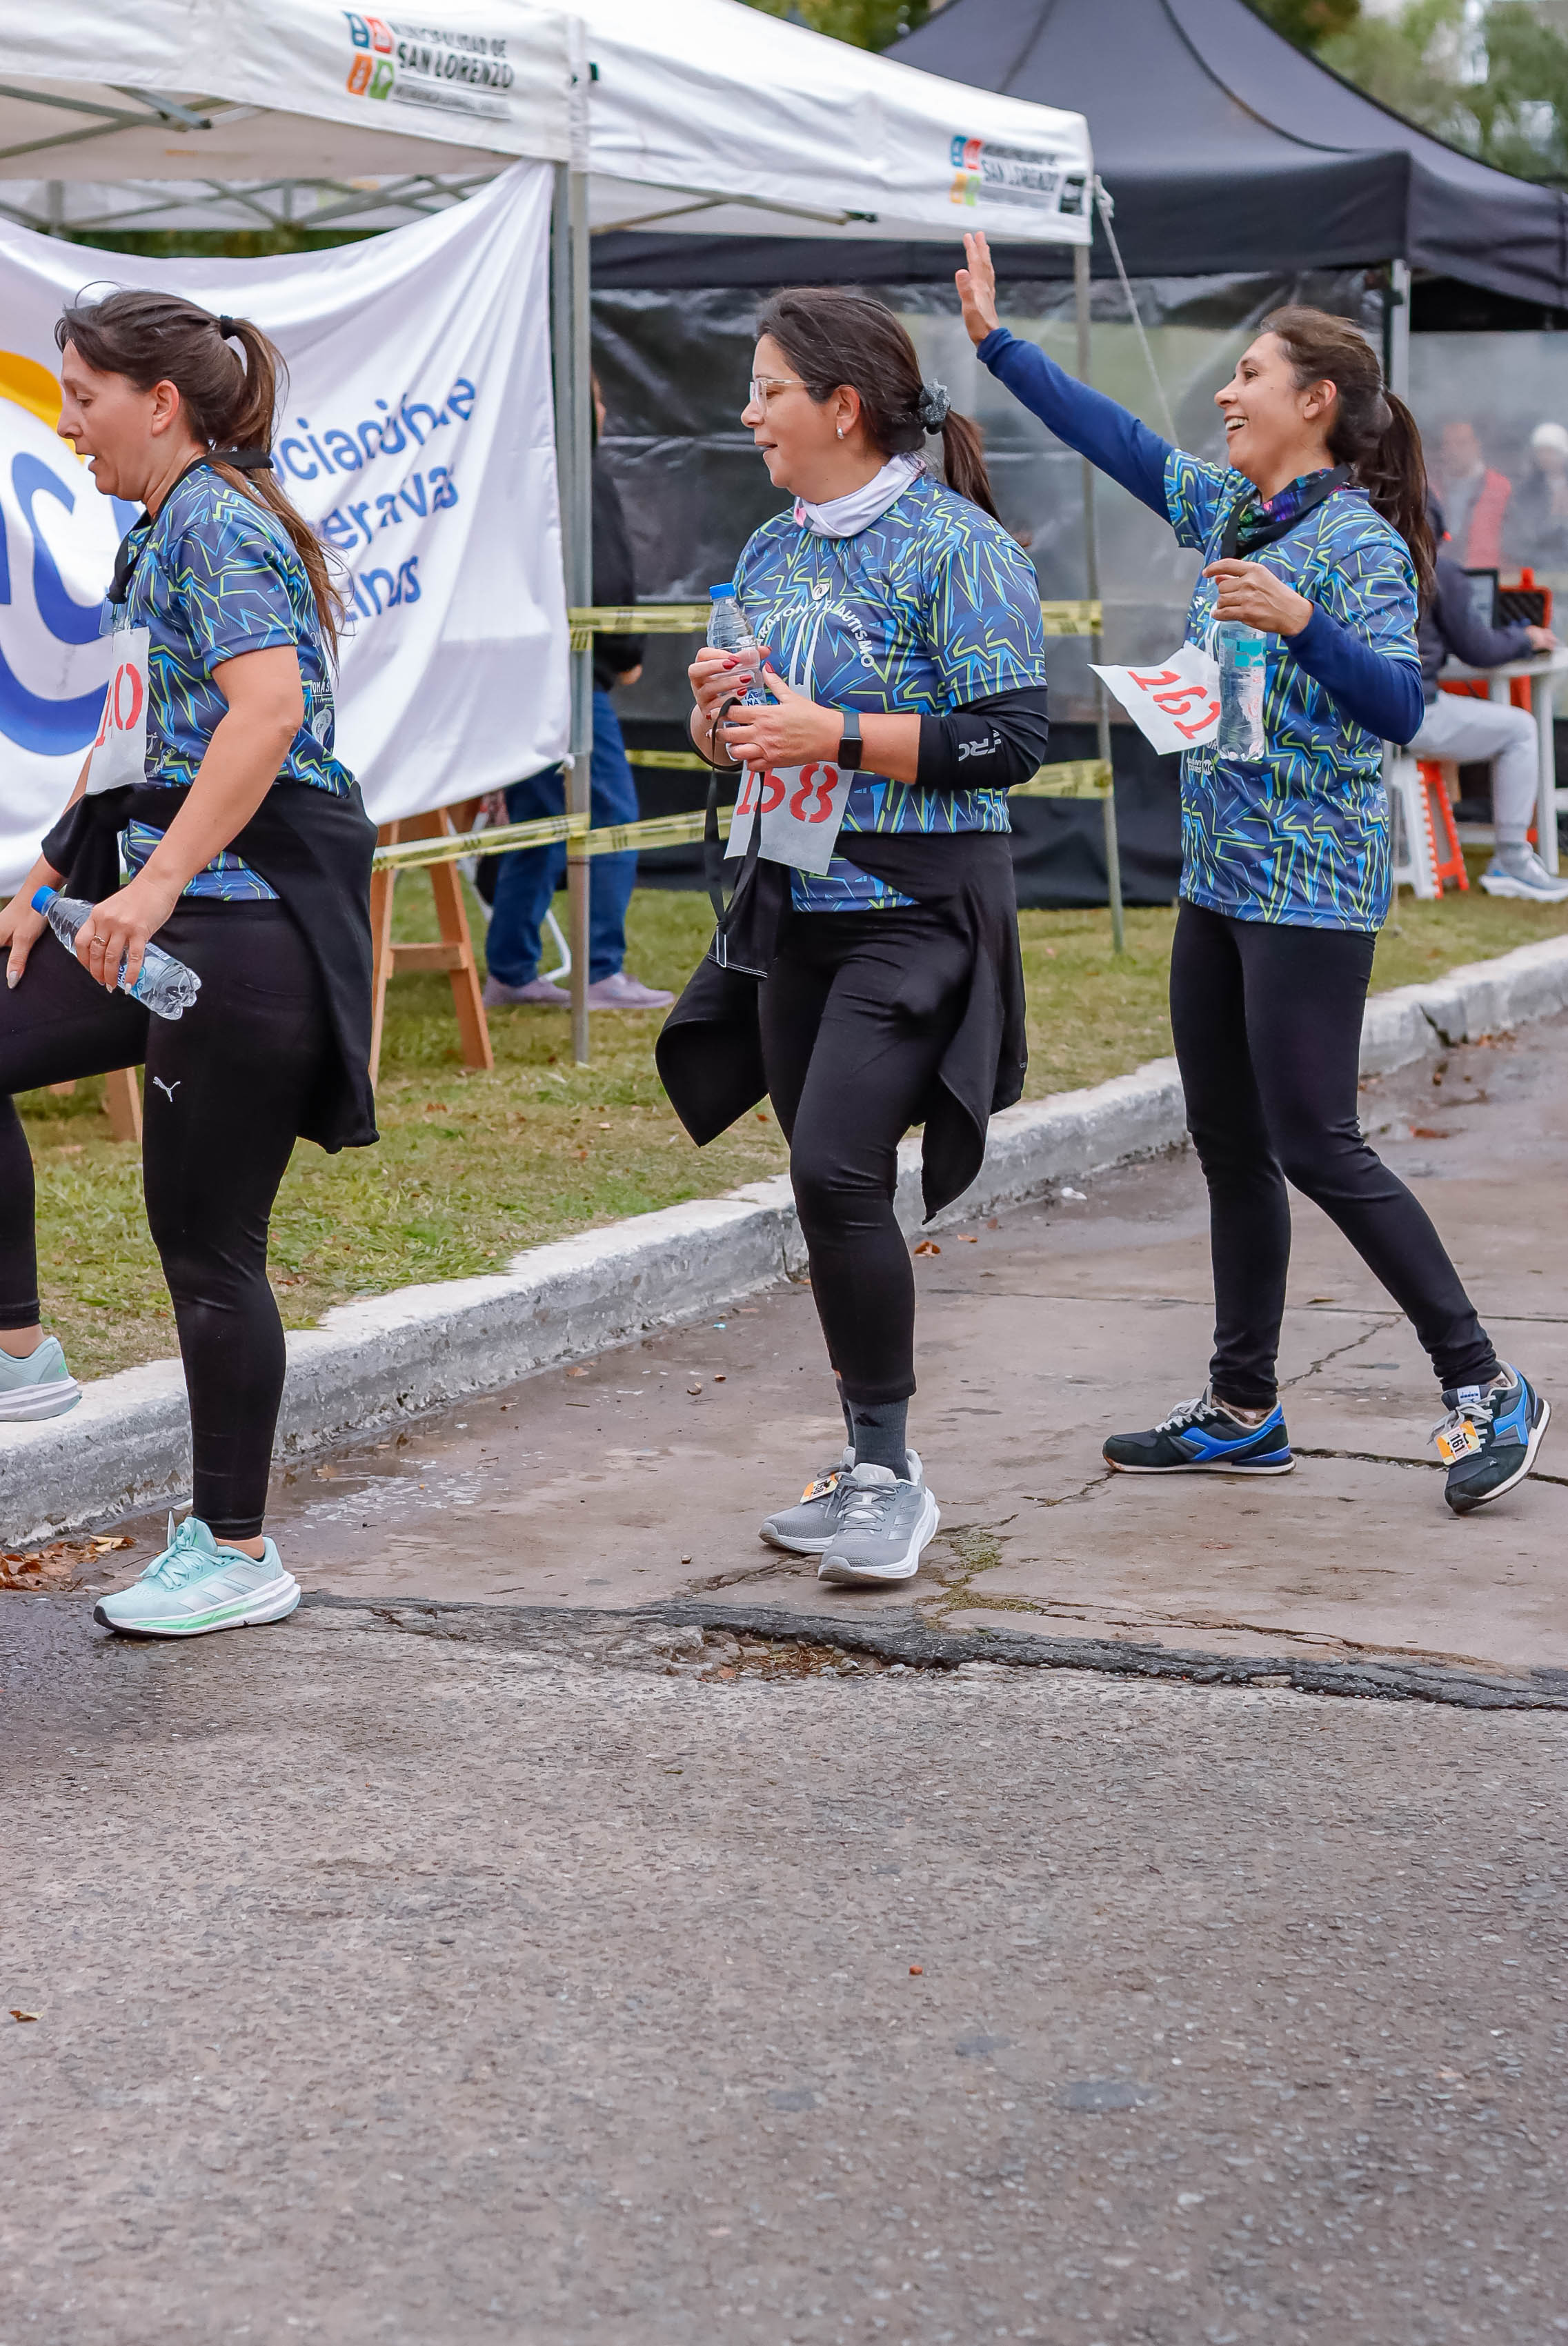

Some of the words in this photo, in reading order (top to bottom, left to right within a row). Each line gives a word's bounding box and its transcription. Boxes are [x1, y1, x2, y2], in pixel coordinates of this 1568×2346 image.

[397, 41, 432, 74] SAN
[435, 50, 515, 88] LORENZO
[834, 605, 875, 668] AUTISMO
[1449, 1433, 1465, 1453] 161
